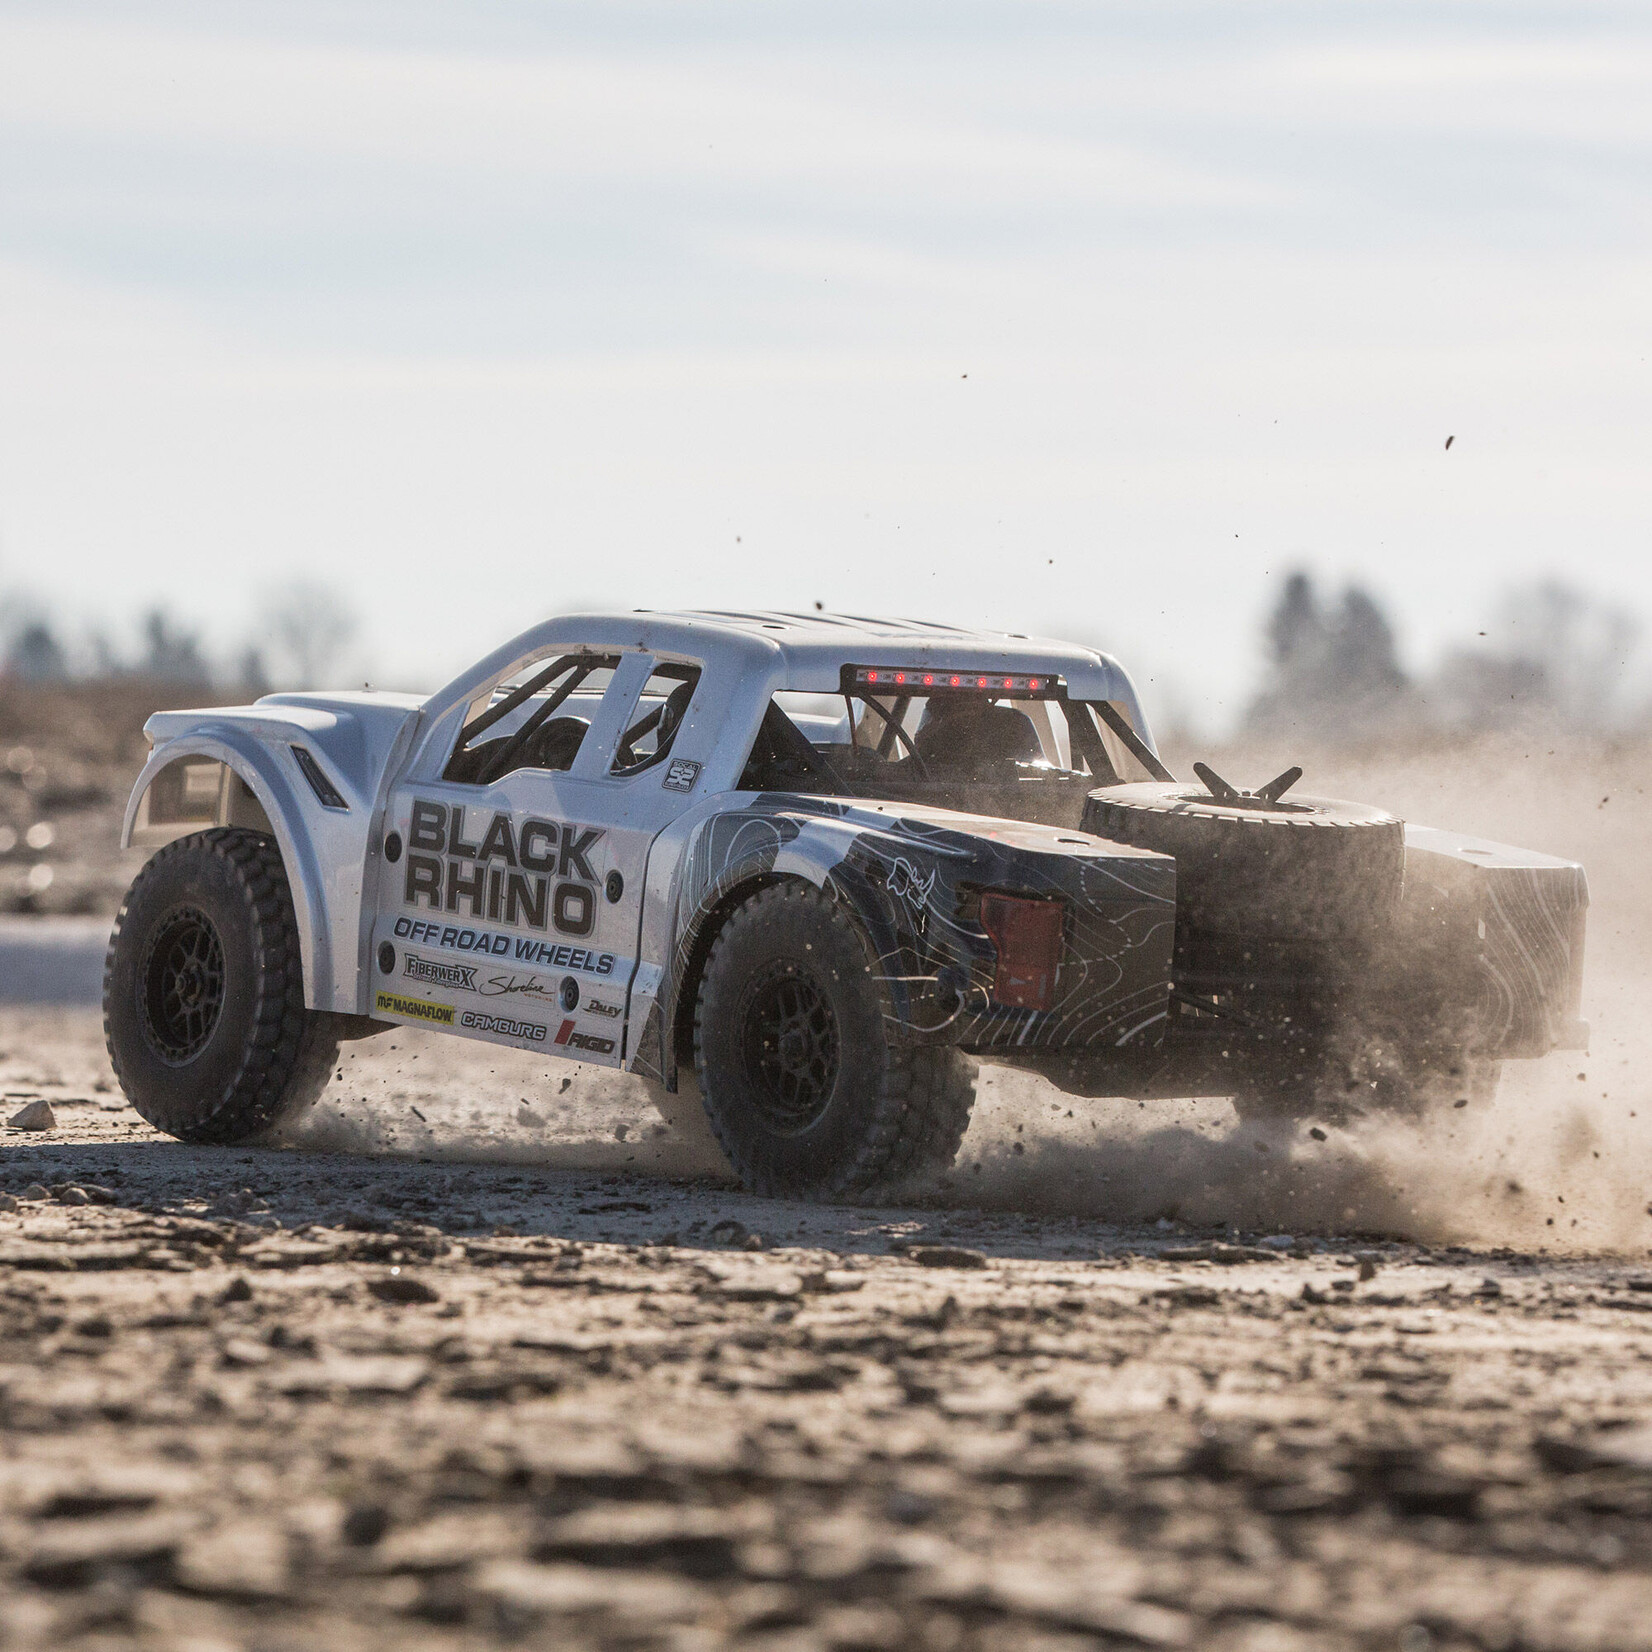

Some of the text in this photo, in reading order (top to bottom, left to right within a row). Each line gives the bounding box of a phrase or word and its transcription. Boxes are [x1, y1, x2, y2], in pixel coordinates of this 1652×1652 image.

[408, 797, 606, 887] BLACK
[403, 852, 598, 939] RHINO
[393, 916, 615, 976] OFF ROAD WHEELS
[393, 999, 453, 1023] MAGNAFLOW
[461, 1011, 547, 1041] CAMBURG
[566, 1031, 617, 1054] RIGID
